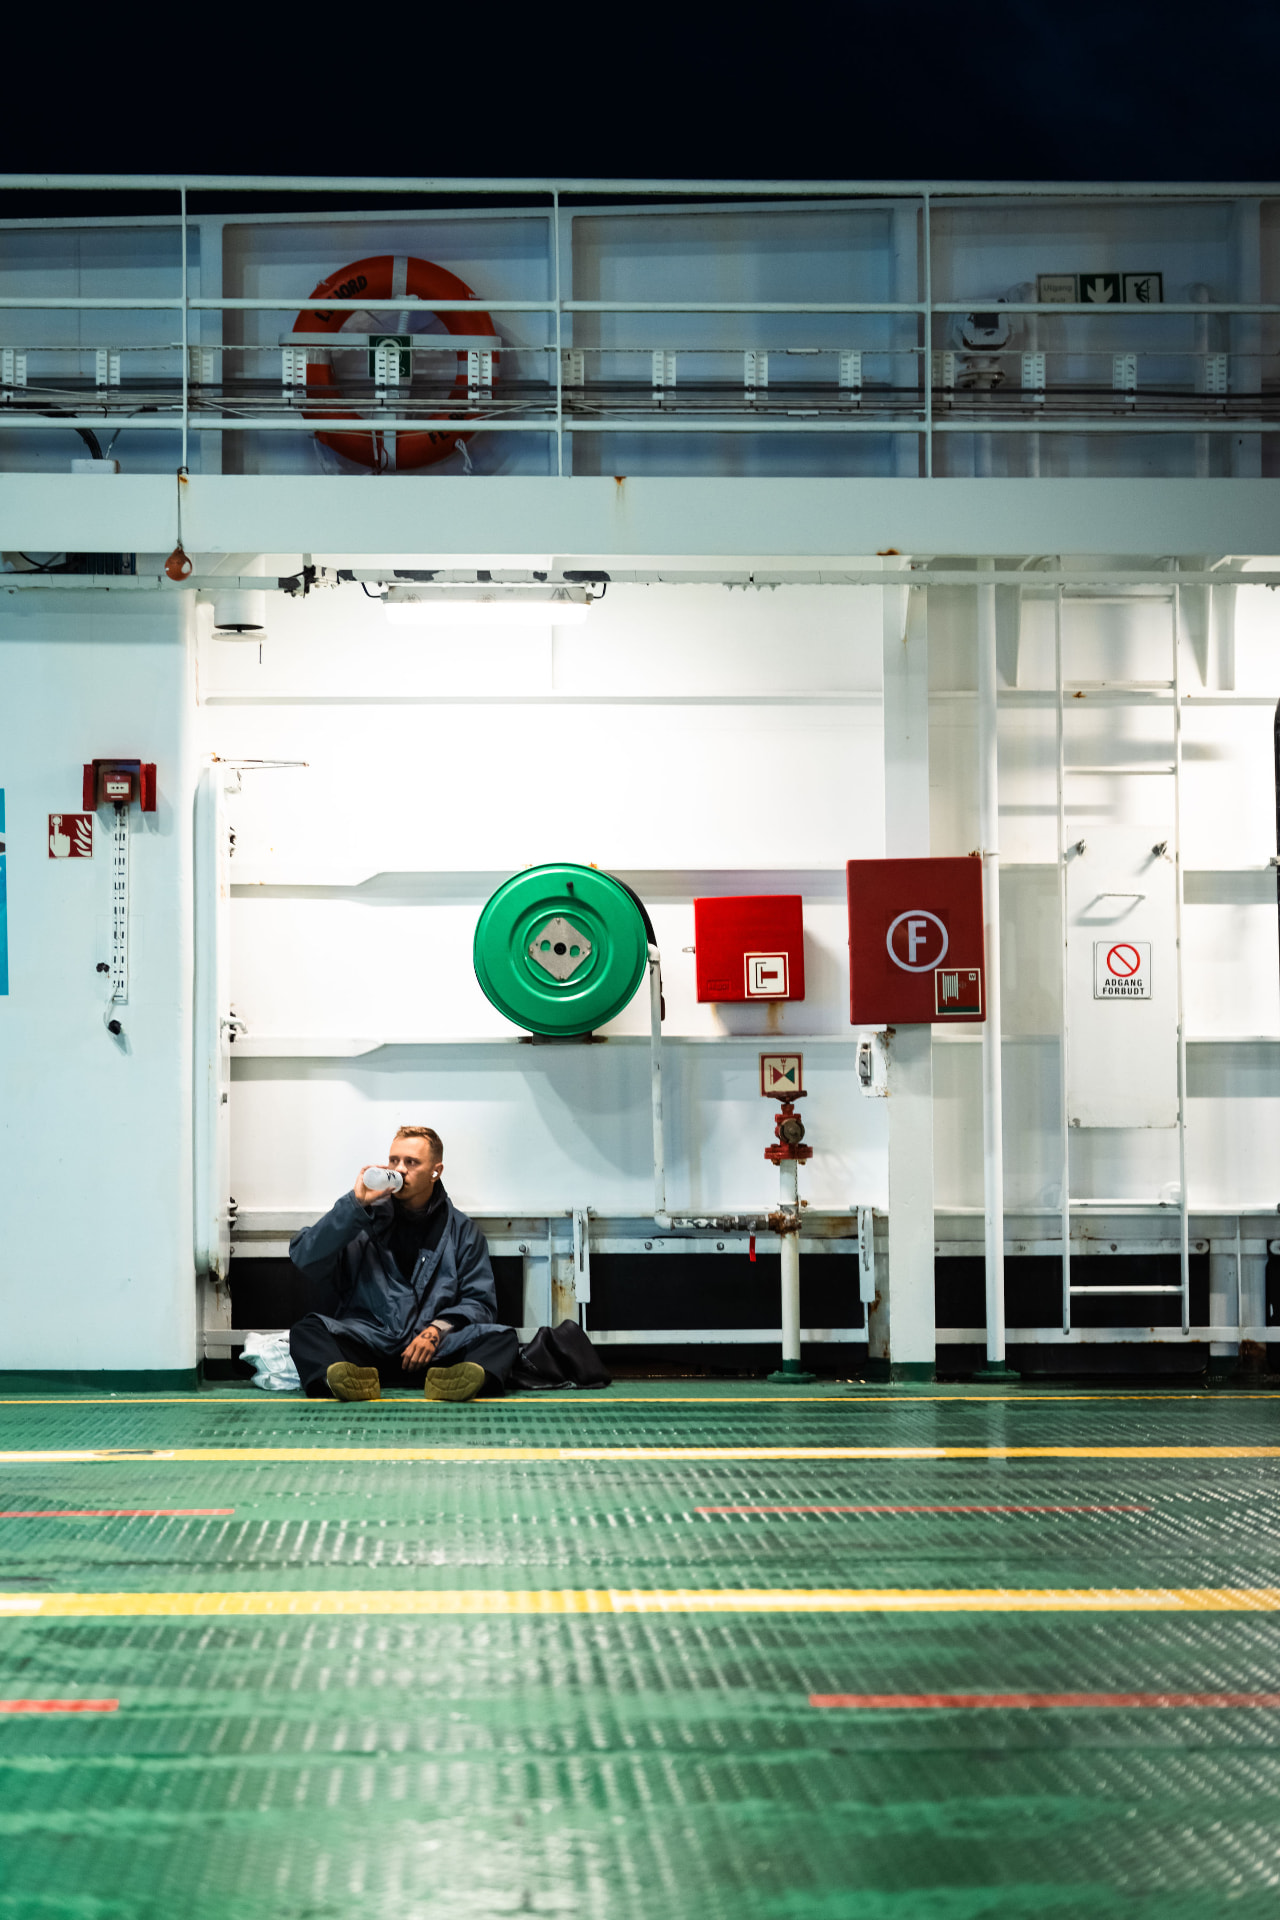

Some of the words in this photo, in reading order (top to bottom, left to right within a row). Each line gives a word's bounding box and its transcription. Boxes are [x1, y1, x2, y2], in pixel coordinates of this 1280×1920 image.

[907, 920, 927, 963] F
[1105, 978, 1143, 987] ADGANG
[1102, 987, 1145, 995] FORBUDT
